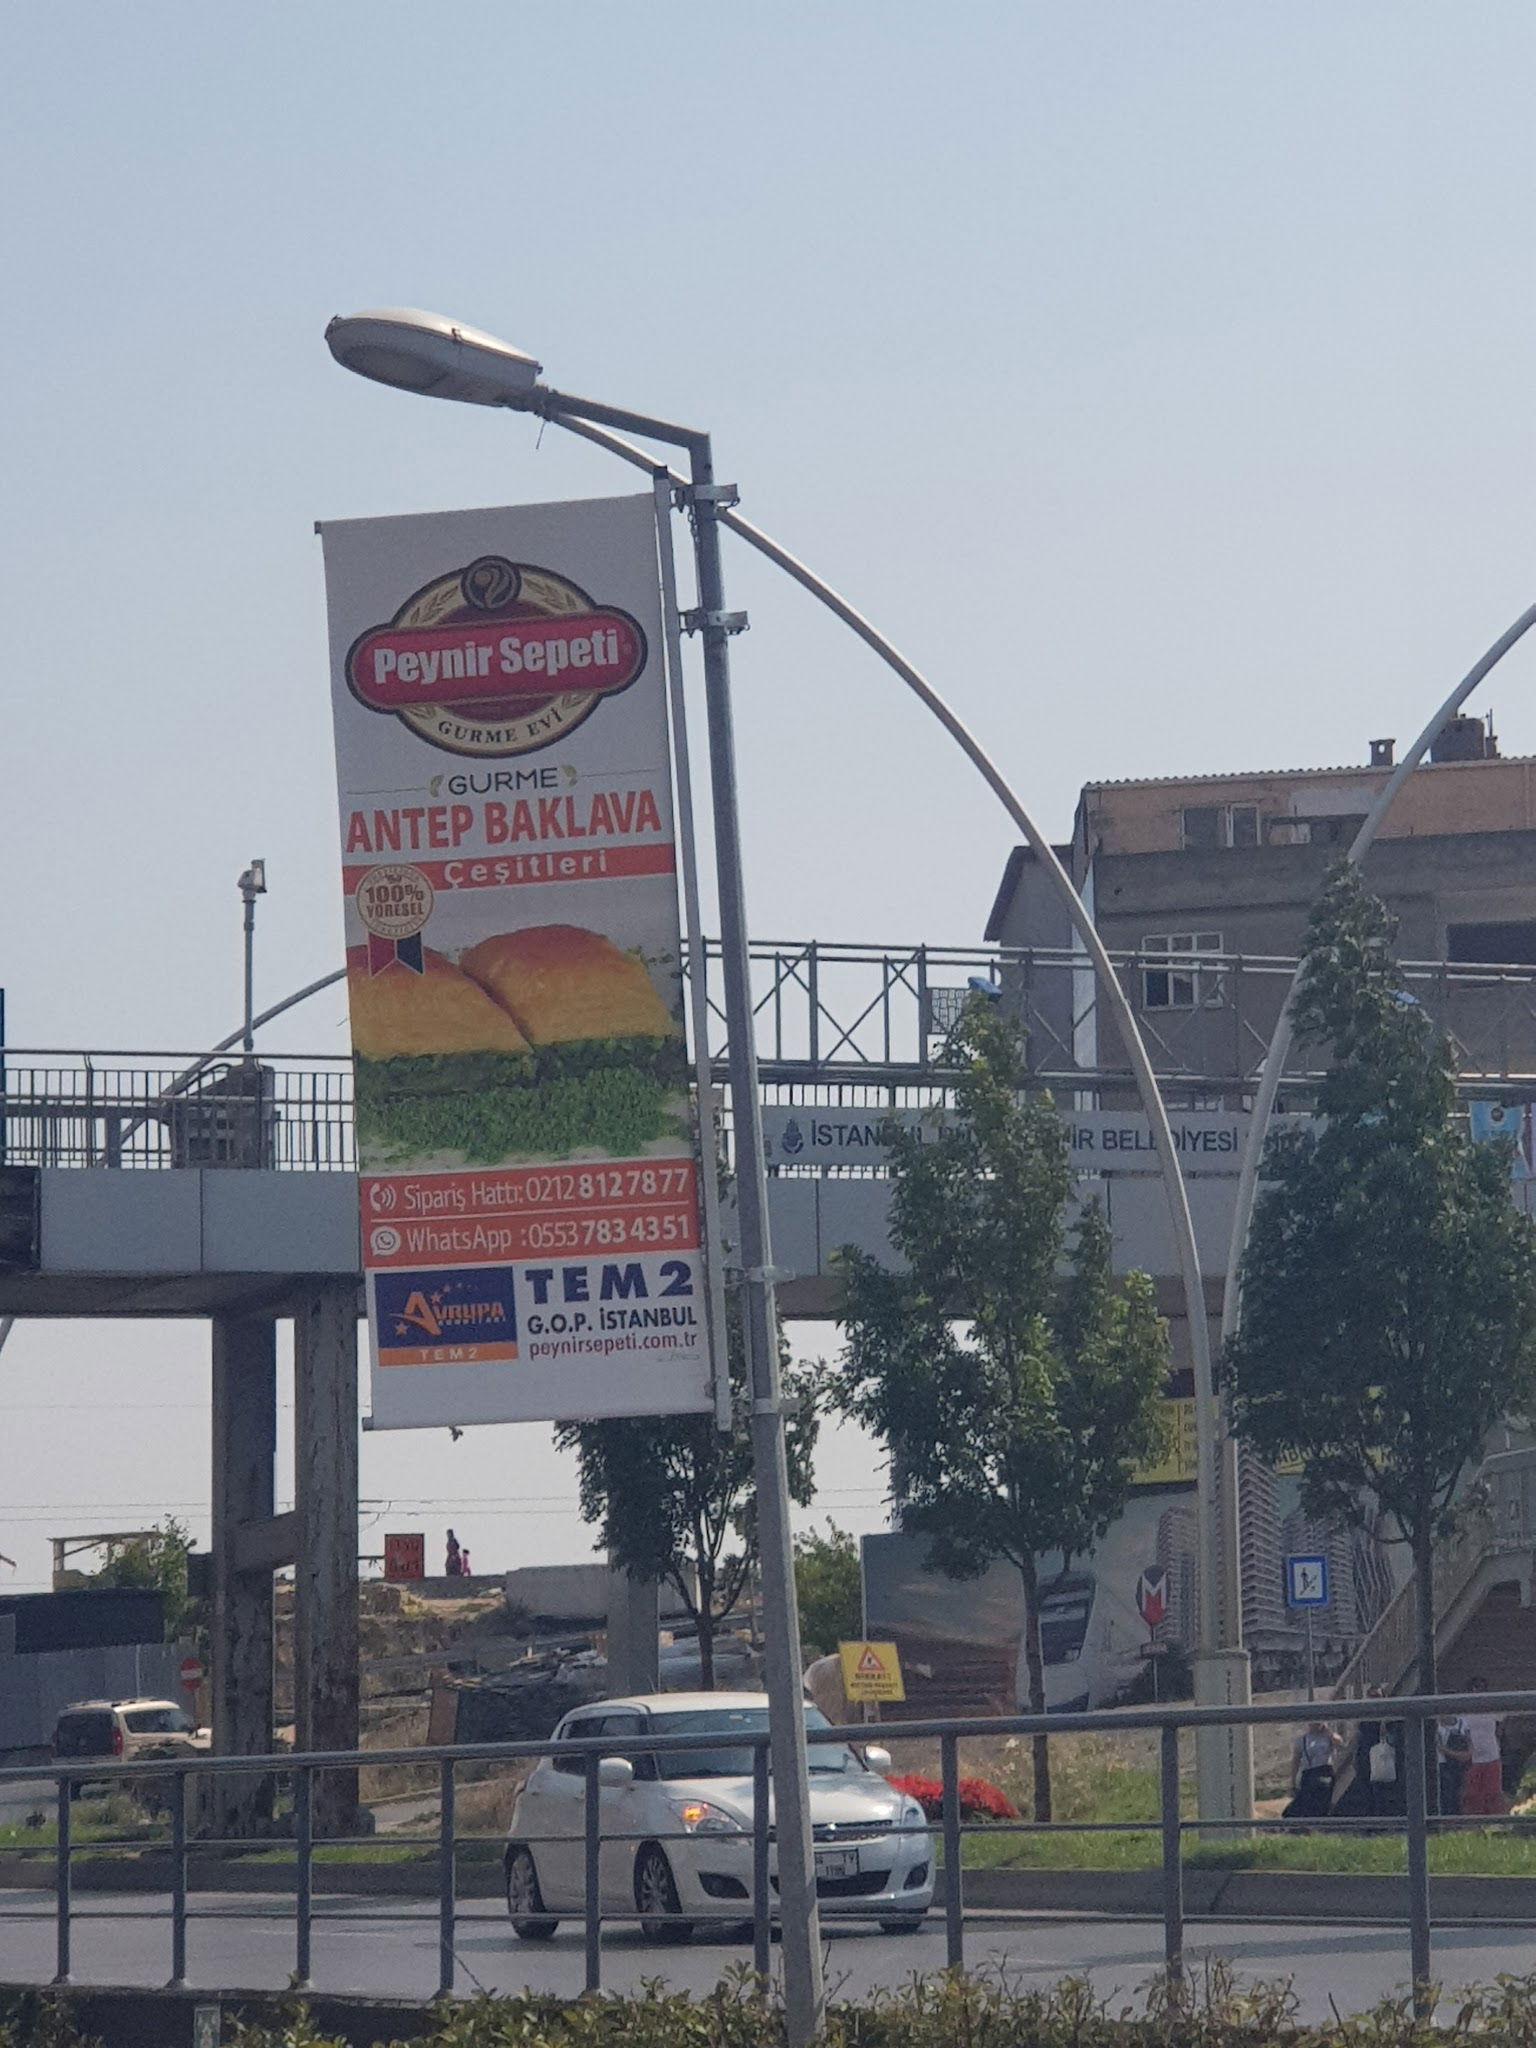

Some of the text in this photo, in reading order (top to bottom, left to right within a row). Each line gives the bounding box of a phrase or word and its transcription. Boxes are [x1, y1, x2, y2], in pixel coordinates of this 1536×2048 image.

[373, 629, 619, 685] Peynir Sepeti
[438, 707, 564, 744] GURME EVİ
[448, 767, 558, 795] GURME
[346, 789, 662, 853] ANTEP BAKLAVA
[444, 849, 608, 889] Çeşitleri
[365, 884, 424, 904] 100%
[811, 1119, 932, 1150] İSTANL
[404, 1184, 465, 1215] Sipariş
[526, 1176, 574, 1201] 0212
[406, 1226, 512, 1253] WhatsApp
[525, 1260, 693, 1304] TEM 2
[527, 1312, 592, 1335] G.O.P.
[600, 1306, 697, 1331] İSTANBUL
[420, 1347, 478, 1361] TEM 2
[530, 1332, 697, 1361] peynirsepeti.com.tr
